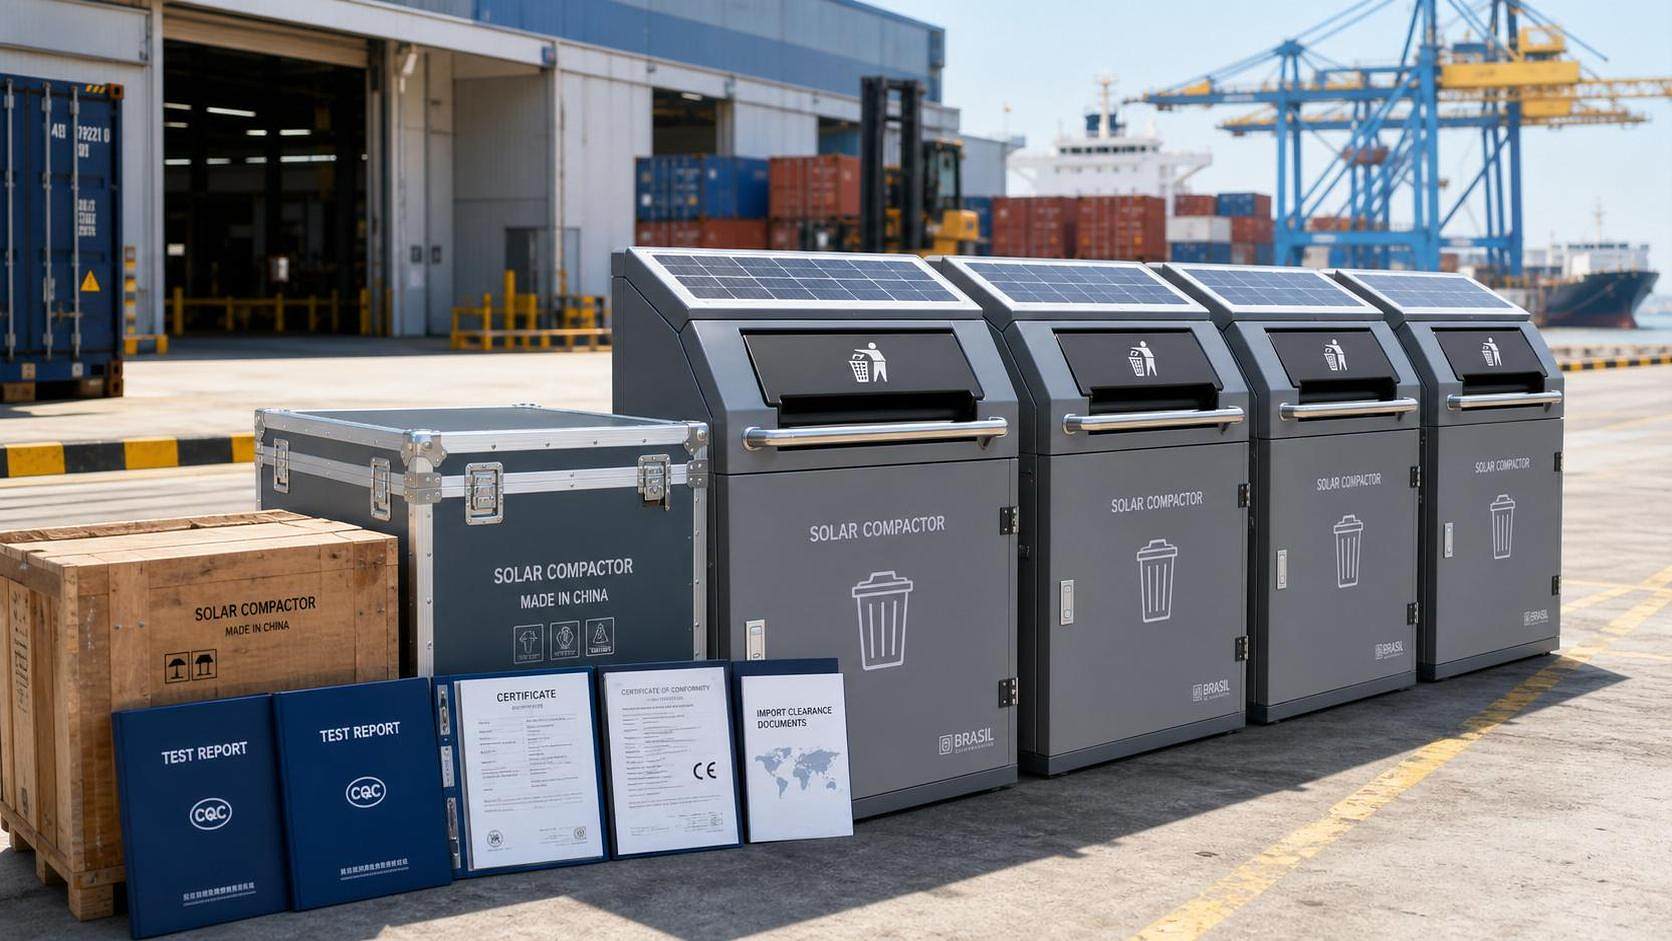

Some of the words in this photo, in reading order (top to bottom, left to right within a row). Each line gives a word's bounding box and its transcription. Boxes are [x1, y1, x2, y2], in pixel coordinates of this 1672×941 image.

[1475, 460, 1494, 473] SOLAR
[1316, 476, 1340, 491] SOLAR
[1341, 473, 1382, 488] COMPACTOR
[1111, 497, 1144, 513] SOLAR
[1146, 491, 1203, 510] COMPACTOR
[809, 522, 858, 543] SOLAR
[863, 515, 945, 538] COMPACTOR
[494, 565, 543, 584] SOLAR
[546, 558, 633, 580] COMPACTOR
[520, 592, 555, 609] MADE
[558, 591, 570, 606] IN
[573, 587, 609, 604] CHINA
[195, 604, 237, 622] SOLAR
[240, 596, 316, 616] COMPACTOR
[225, 624, 250, 637] MADE
[252, 623, 261, 633] IN
[263, 620, 290, 632] CHINA
[496, 689, 557, 702] CERTIFICATE
[620, 686, 660, 696] CERTIFICATE
[1203, 679, 1230, 695] BRASIL
[756, 708, 786, 718] IMPORT
[788, 706, 833, 716] CLEARANCE
[319, 727, 350, 743] TEST
[353, 721, 400, 739] REPORT
[757, 718, 807, 729] DOCUMENTS
[954, 727, 994, 748] BRASIL
[161, 748, 194, 765] TEST
[197, 741, 248, 760] REPORT
[693, 761, 717, 780] CE
[351, 784, 382, 800] CQC
[194, 805, 227, 822] CQC
